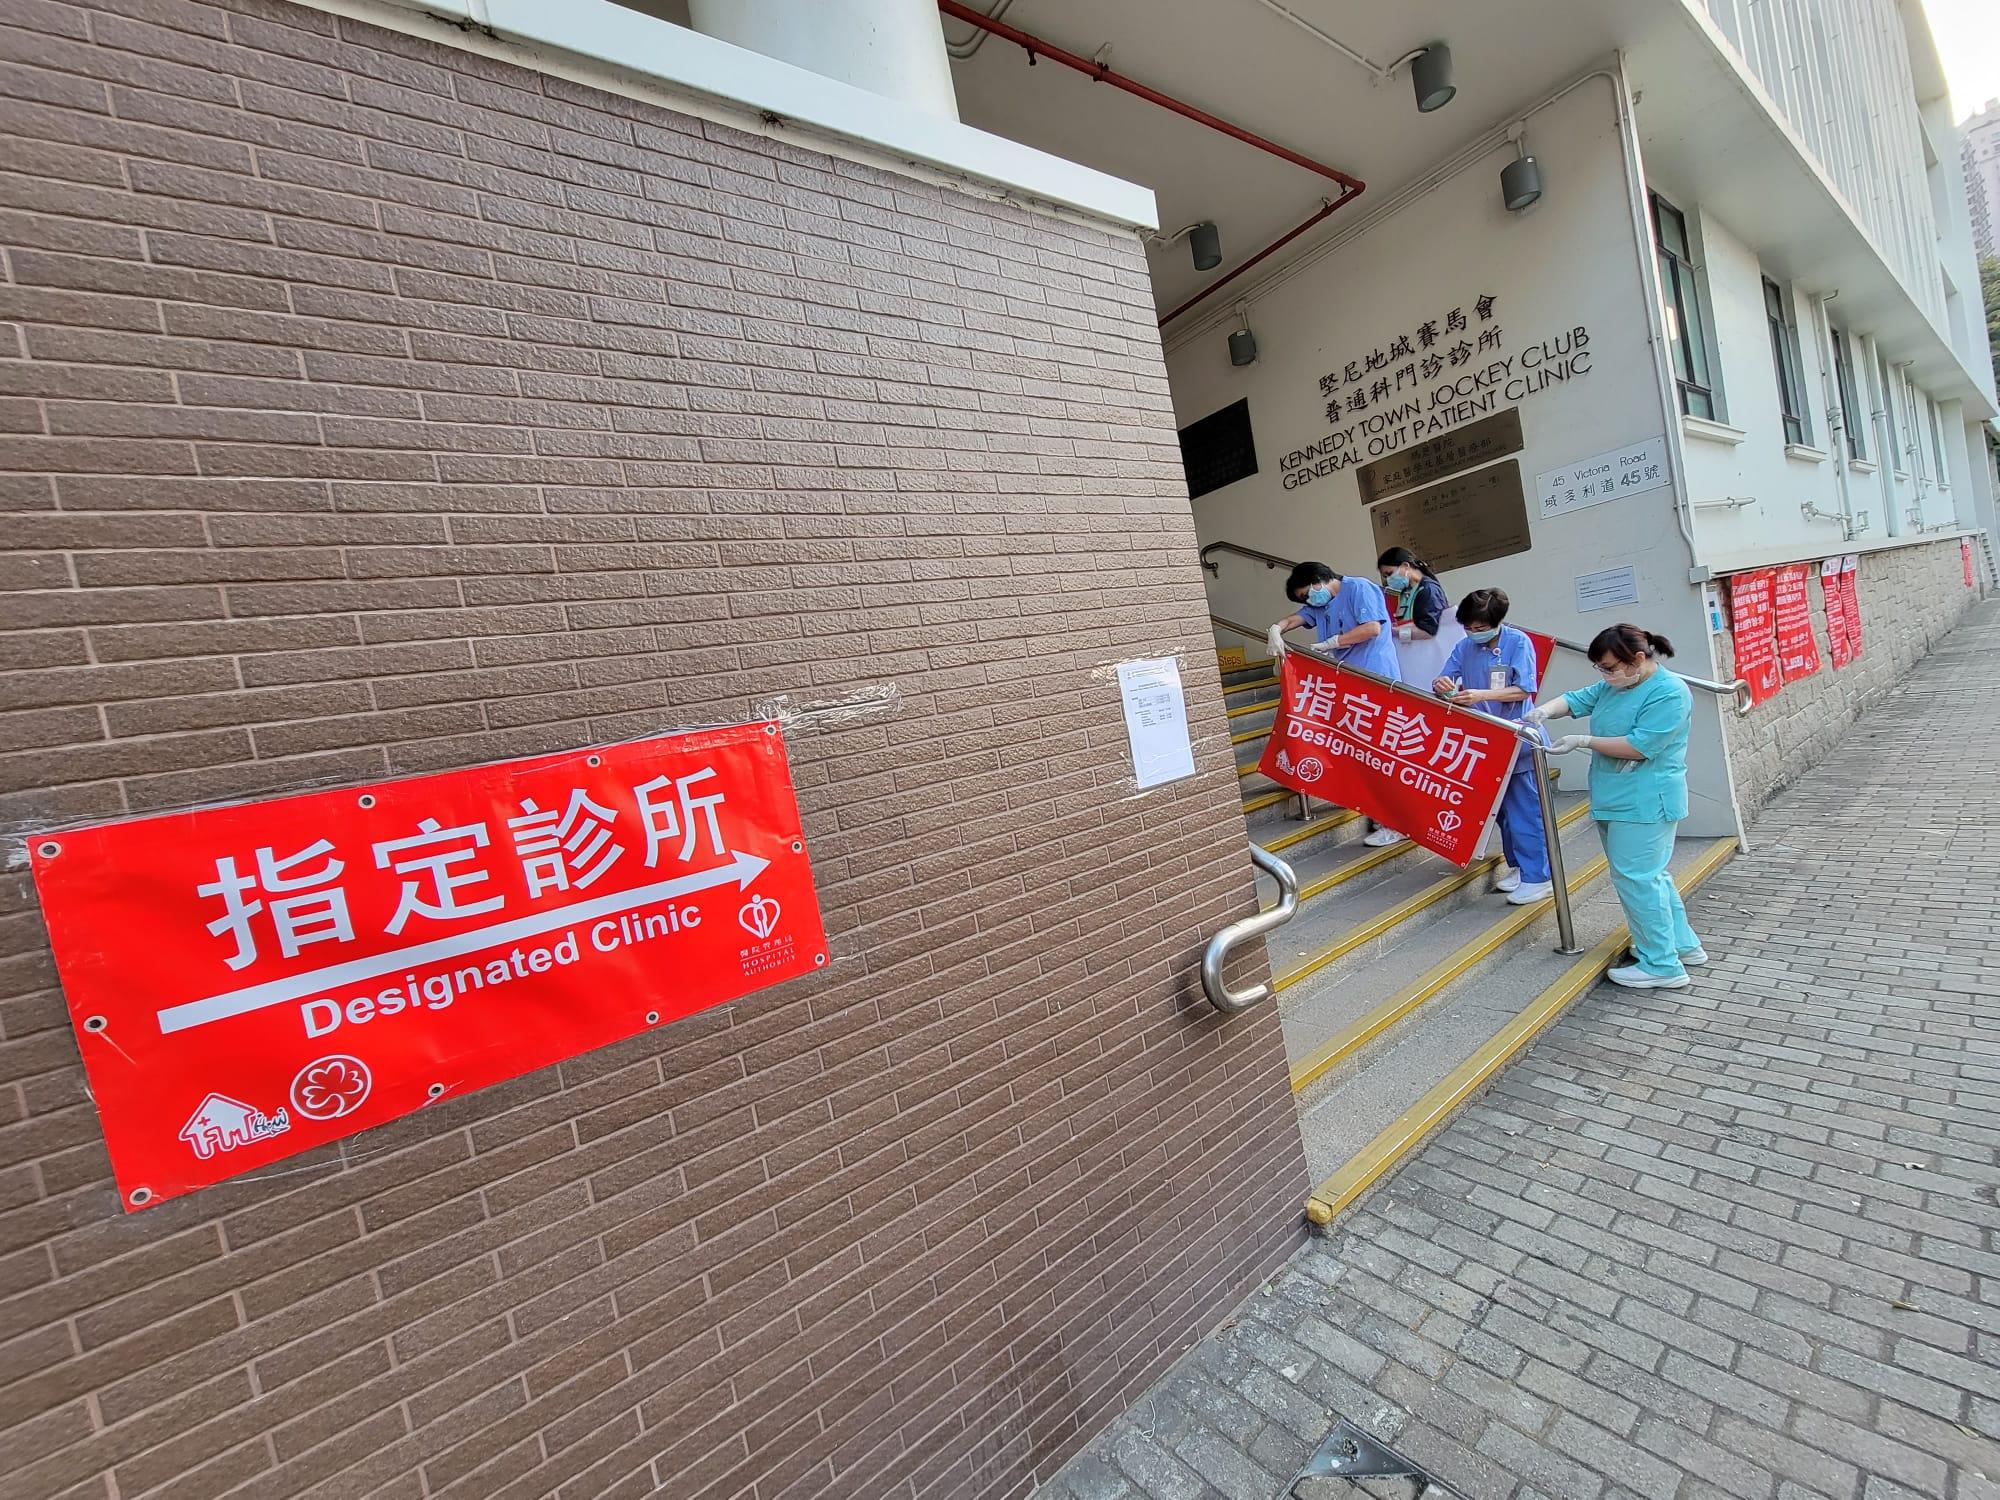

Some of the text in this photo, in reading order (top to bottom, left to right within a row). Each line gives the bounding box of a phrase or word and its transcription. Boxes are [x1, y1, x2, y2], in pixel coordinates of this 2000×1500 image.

[1318, 294, 1498, 397] 堅尼地城賽馬會
[1325, 325, 1503, 424] 普通科門診診所
[1279, 426, 1355, 473] KENNEDY
[1358, 398, 1421, 437] TOWN
[1427, 355, 1514, 410] JOCKEY
[1521, 326, 1590, 369] CLUB
[1282, 447, 1363, 490] GENERAL
[1368, 426, 1406, 456] OUT
[1413, 389, 1497, 439] PATIENT
[1504, 351, 1593, 401] CLINIC
[1552, 452, 1647, 487] 45 Victoria Road
[1286, 720, 1396, 777] Designated
[1399, 766, 1464, 805] Clinic
[1291, 673, 1490, 783] 指定診所
[196, 766, 729, 972] 指定診所
[300, 903, 703, 1040] Designated Clinic
[743, 947, 795, 969] HOSPITAL
